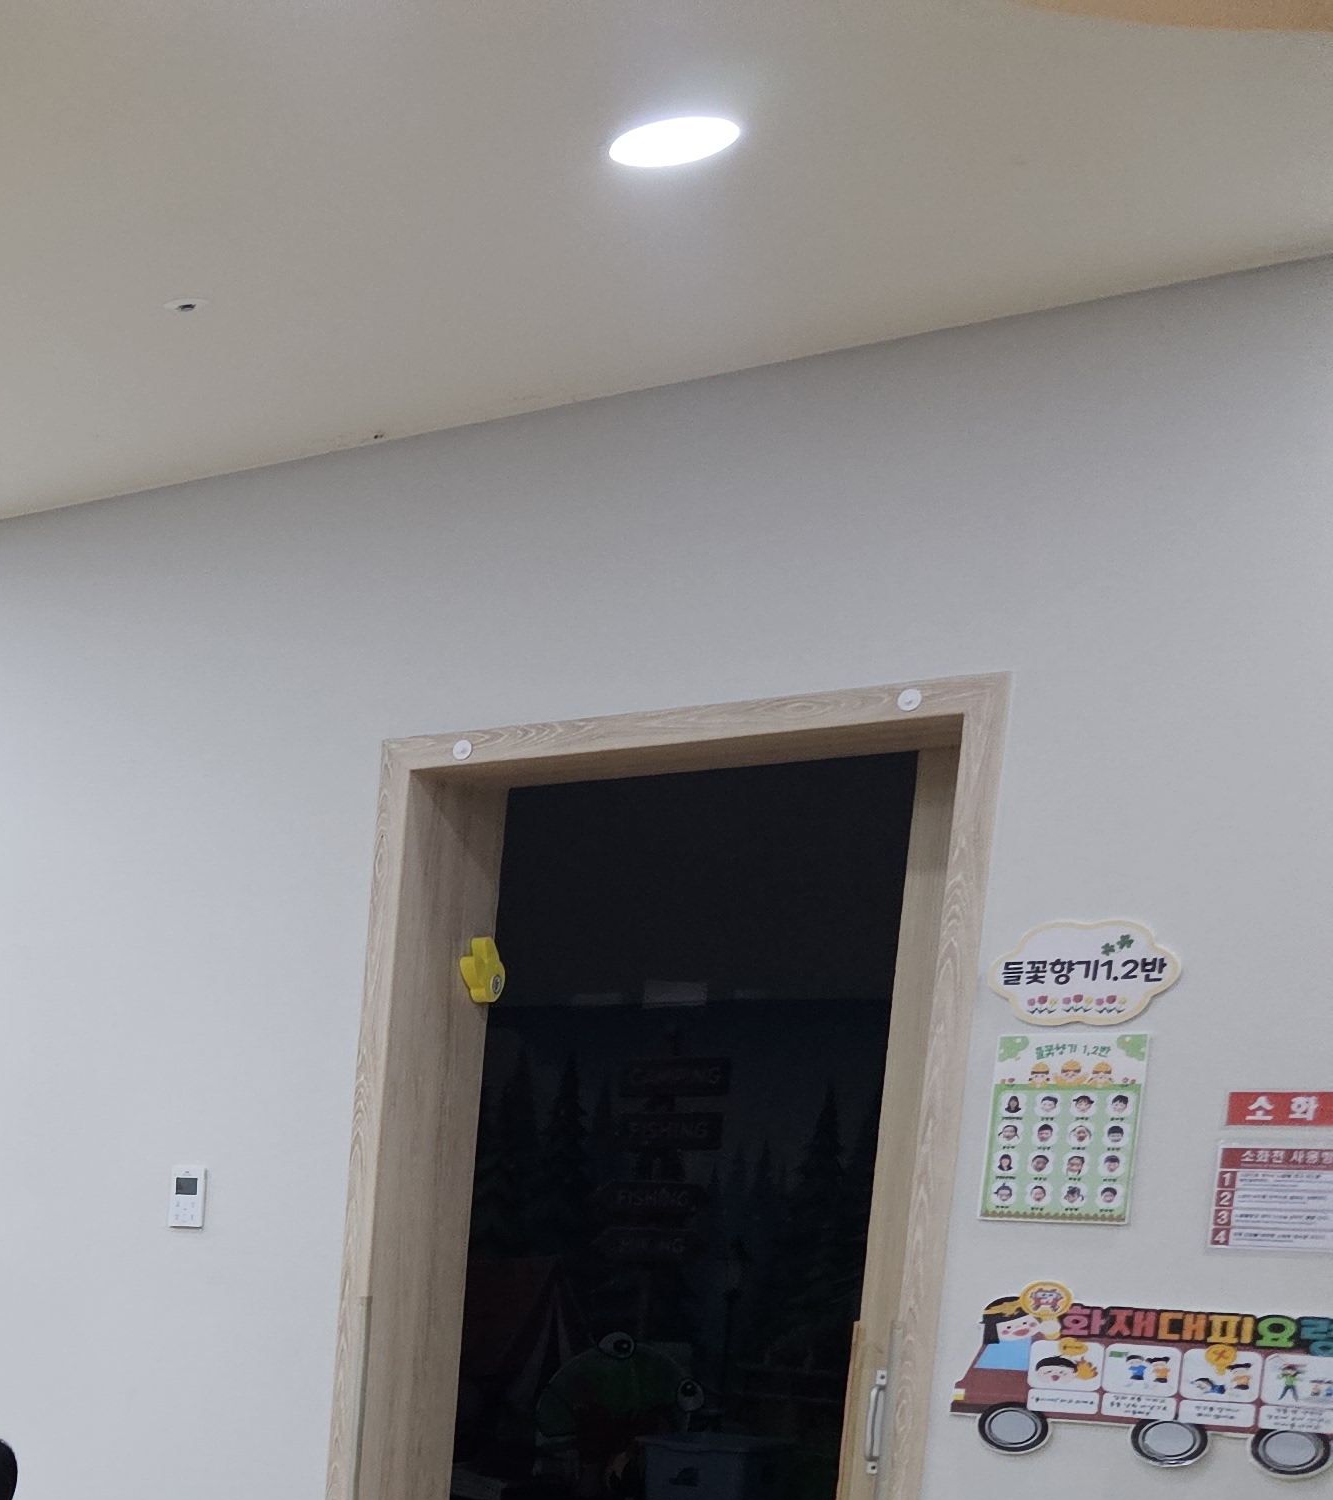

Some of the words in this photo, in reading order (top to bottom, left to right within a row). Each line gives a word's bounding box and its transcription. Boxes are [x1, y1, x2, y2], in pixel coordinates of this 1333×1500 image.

[1222, 1172, 1233, 1187] 1
[1219, 1191, 1232, 1206] 2
[1216, 1210, 1230, 1225] 3
[1214, 1230, 1226, 1244] 4
